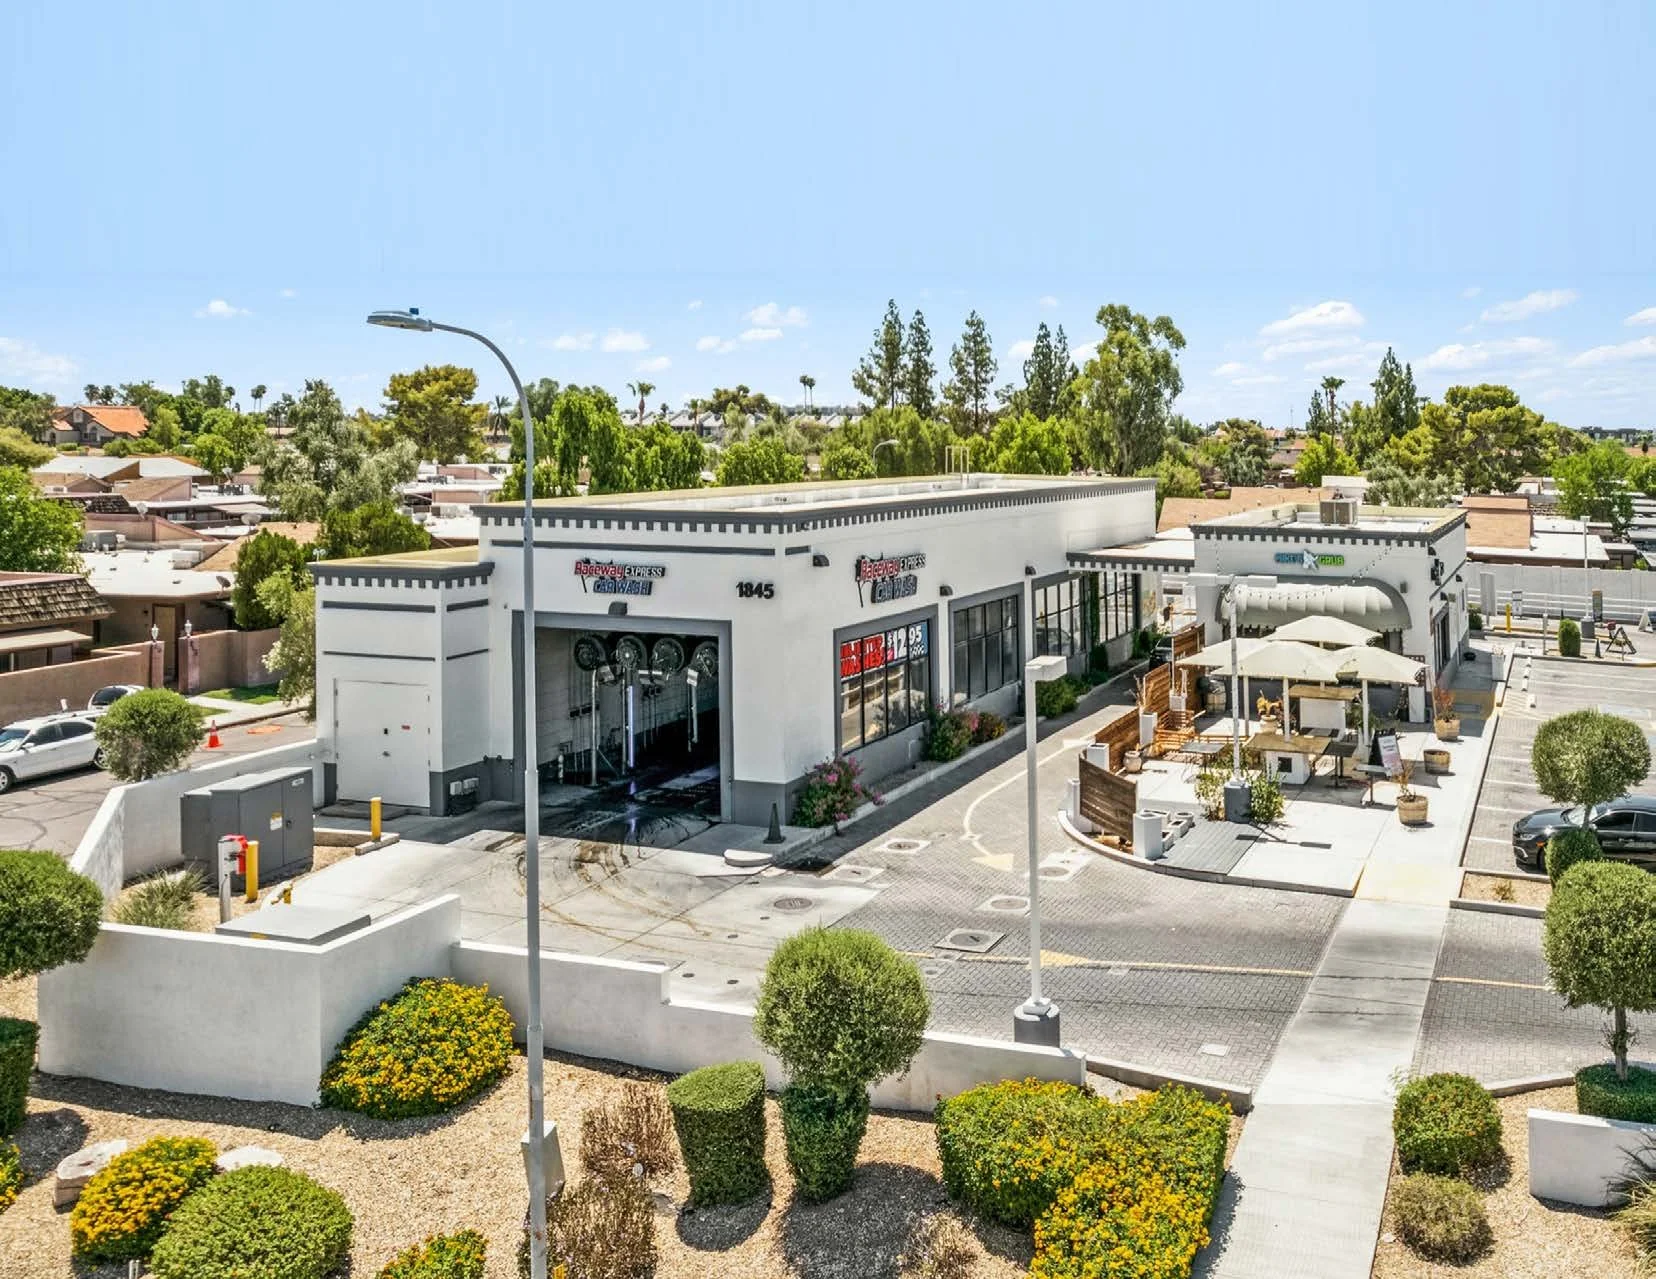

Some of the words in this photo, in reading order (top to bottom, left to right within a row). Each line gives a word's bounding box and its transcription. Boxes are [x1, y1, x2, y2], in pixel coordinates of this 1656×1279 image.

[574, 561, 624, 579] Raceway
[624, 565, 663, 577] EXPRESS
[861, 559, 900, 581] Raceway
[593, 580, 615, 593] CAR
[616, 580, 651, 595] WASH
[736, 581, 775, 599] 1845
[875, 580, 893, 603] CAR
